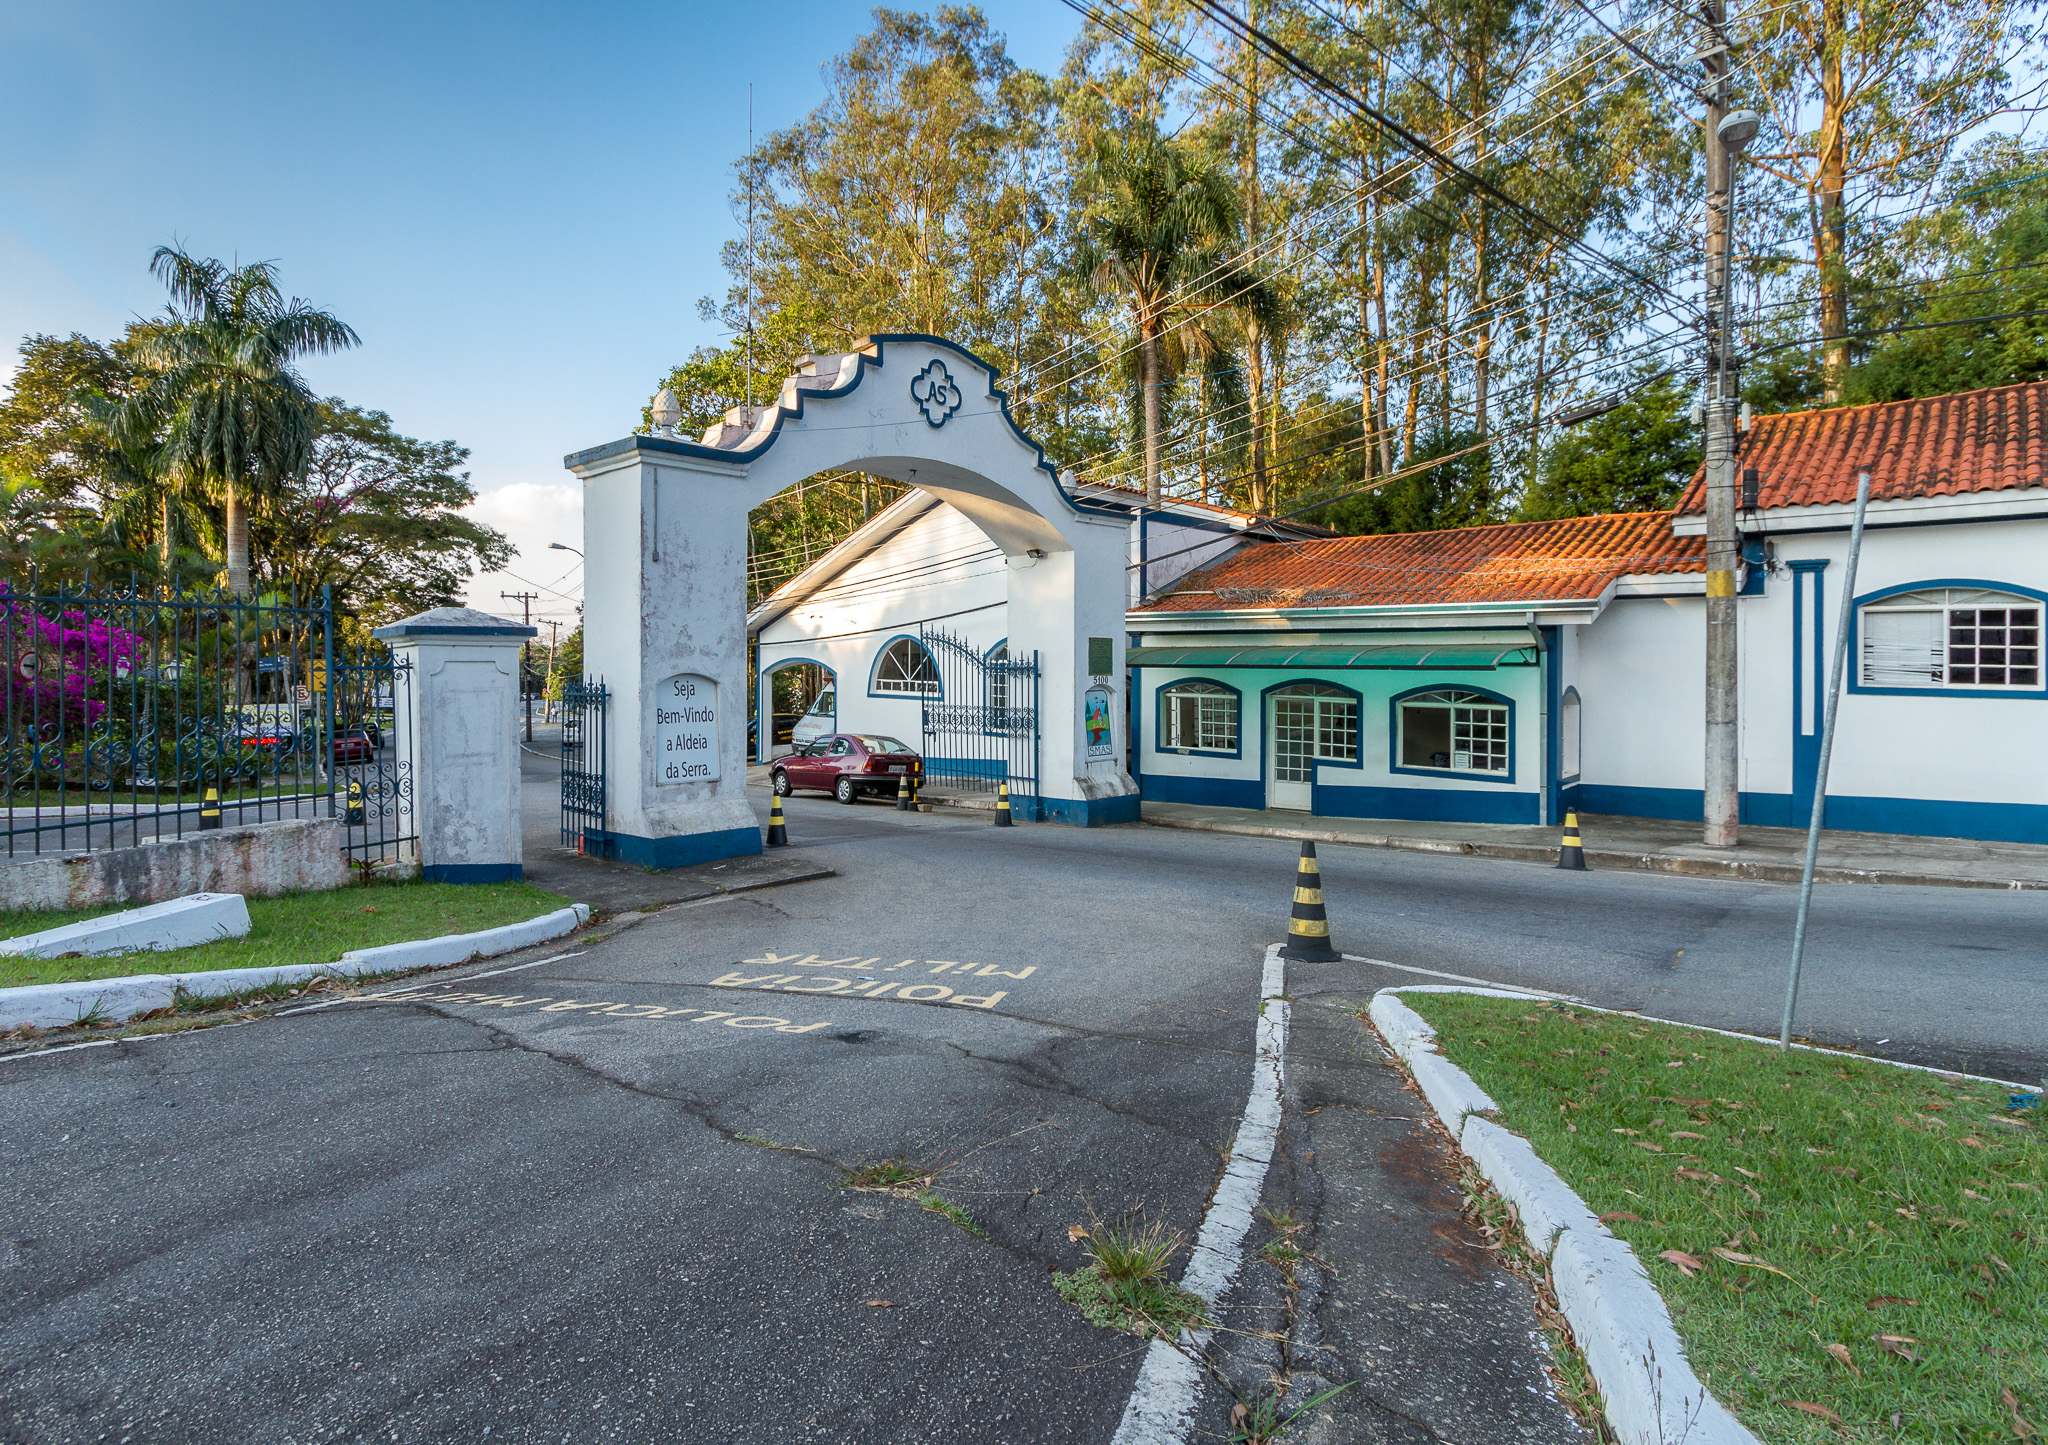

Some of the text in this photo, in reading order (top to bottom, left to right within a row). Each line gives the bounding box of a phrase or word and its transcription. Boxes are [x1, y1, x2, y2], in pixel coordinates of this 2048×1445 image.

[924, 380, 947, 405] AS
[1093, 675, 1109, 685] 5100
[673, 680, 696, 701] Seja
[656, 706, 714, 725] Bem-Vindo
[666, 733, 708, 752] a Aldeia
[1089, 745, 1111, 756] SMAS
[665, 761, 711, 779] da Serra.
